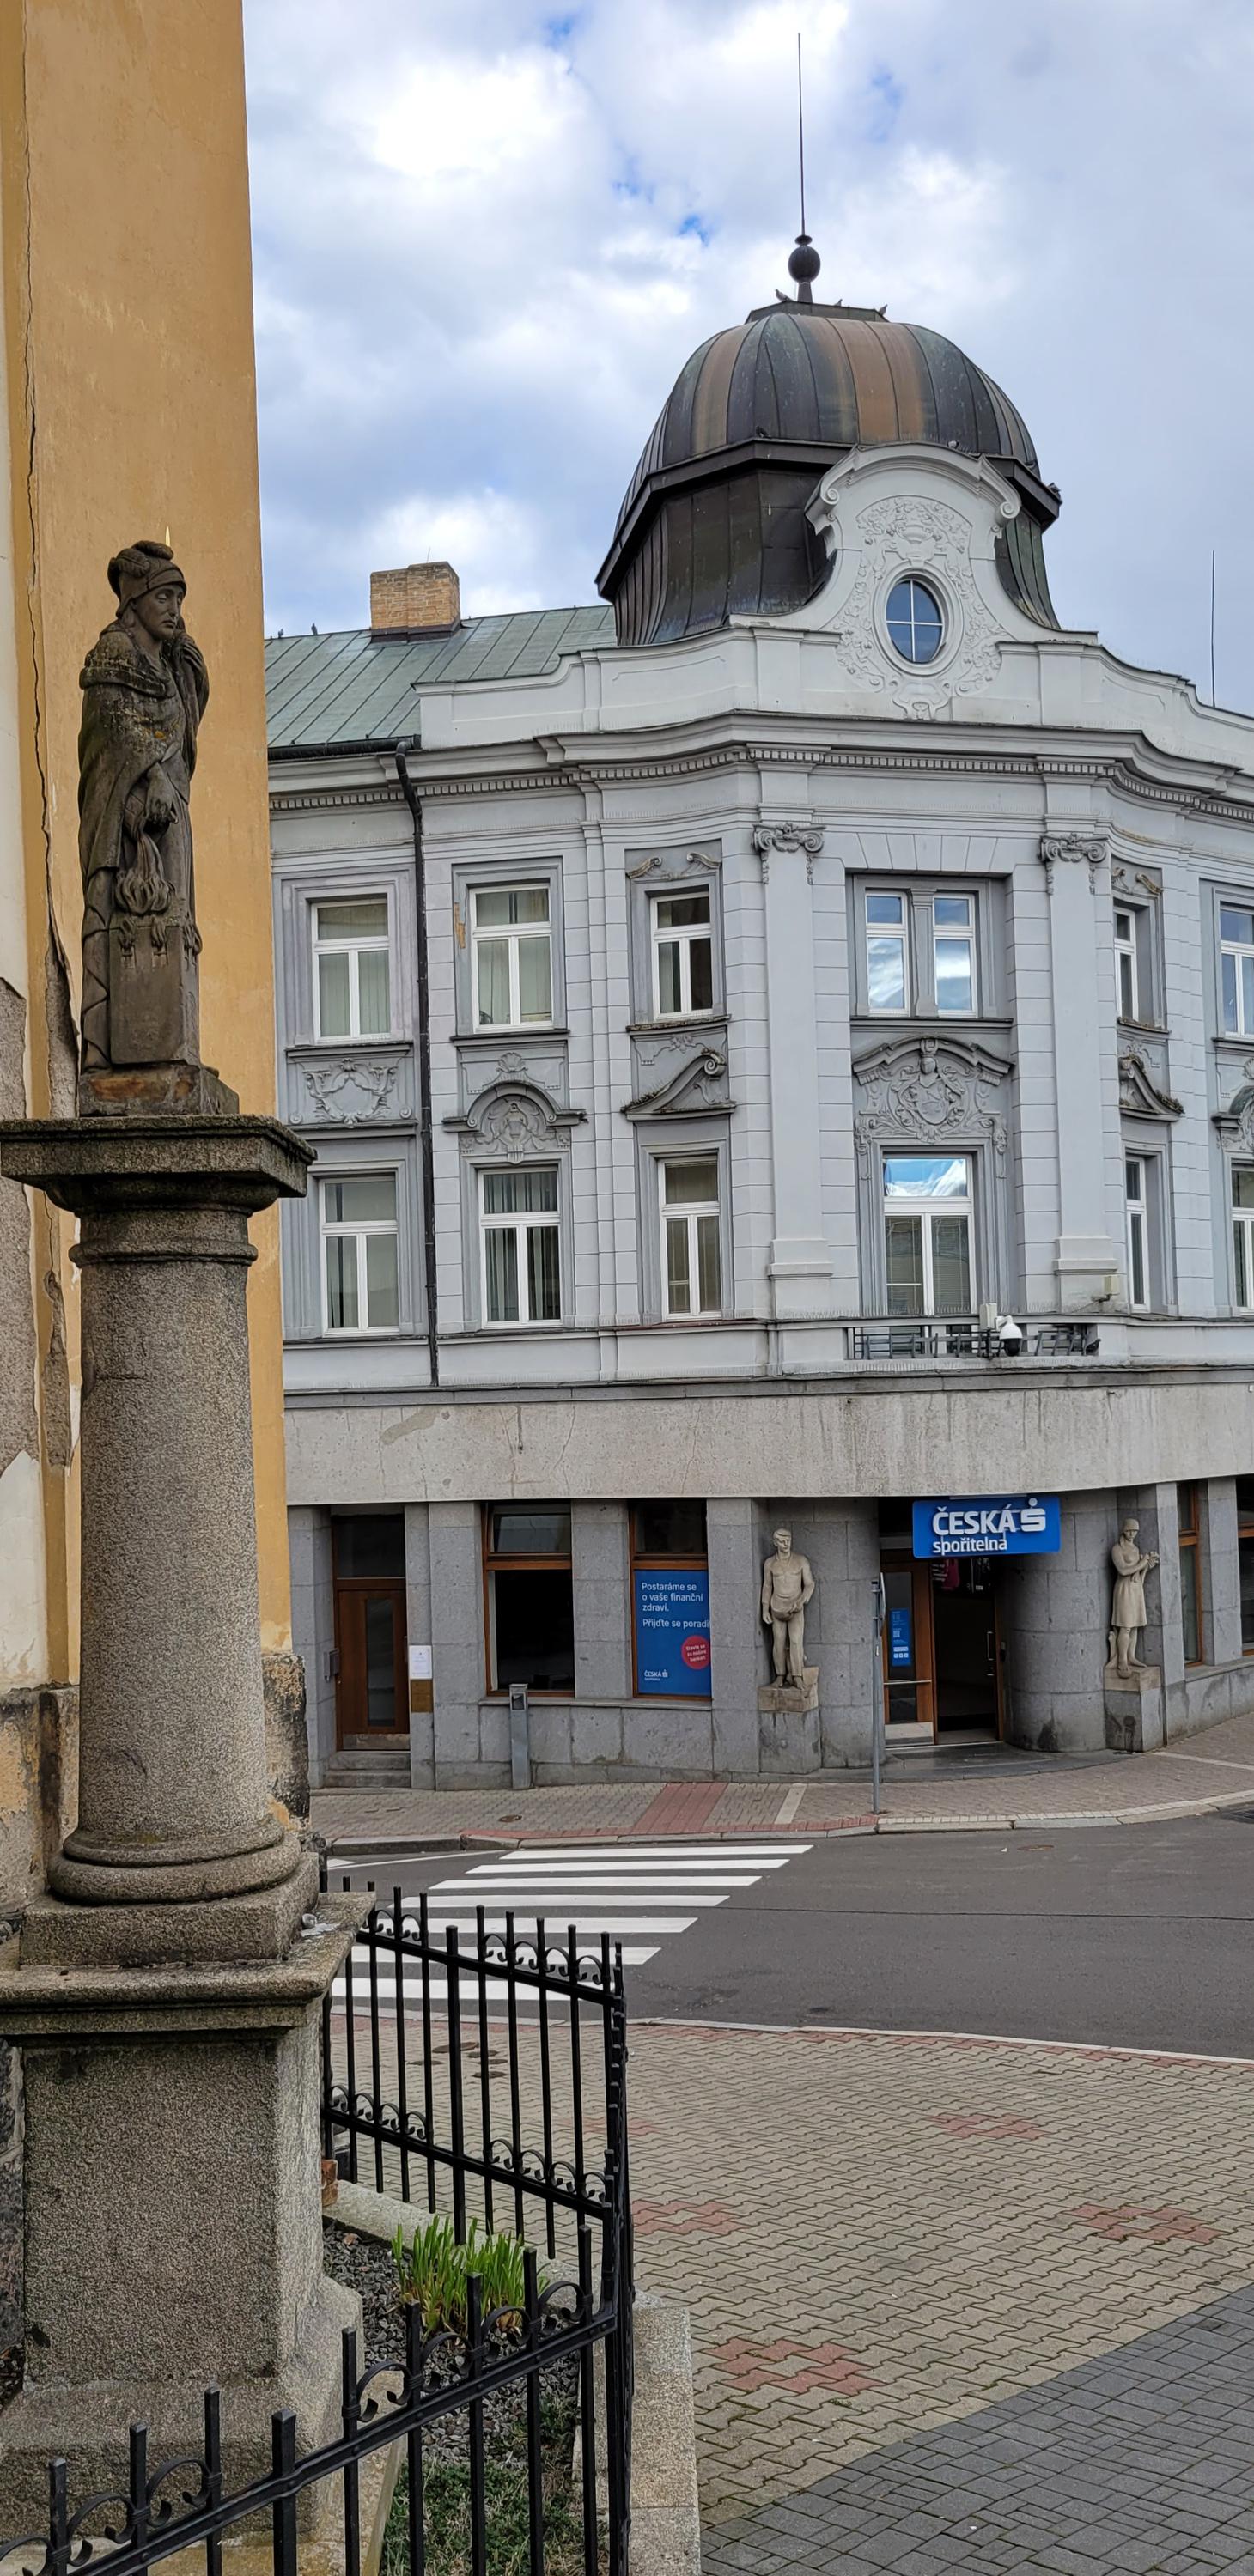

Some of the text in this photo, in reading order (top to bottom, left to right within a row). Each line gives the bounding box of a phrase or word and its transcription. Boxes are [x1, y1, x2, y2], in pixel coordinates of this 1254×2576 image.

[933, 1504, 1016, 1535] ČESKÁ
[933, 1537, 1007, 1556] spořitelna
[642, 1582, 685, 1591] Postaráme
[649, 1592, 668, 1601] vaše
[670, 1592, 703, 1601] finanční
[642, 1602, 670, 1612] zdraví.
[642, 1618, 670, 1629] Přijďte
